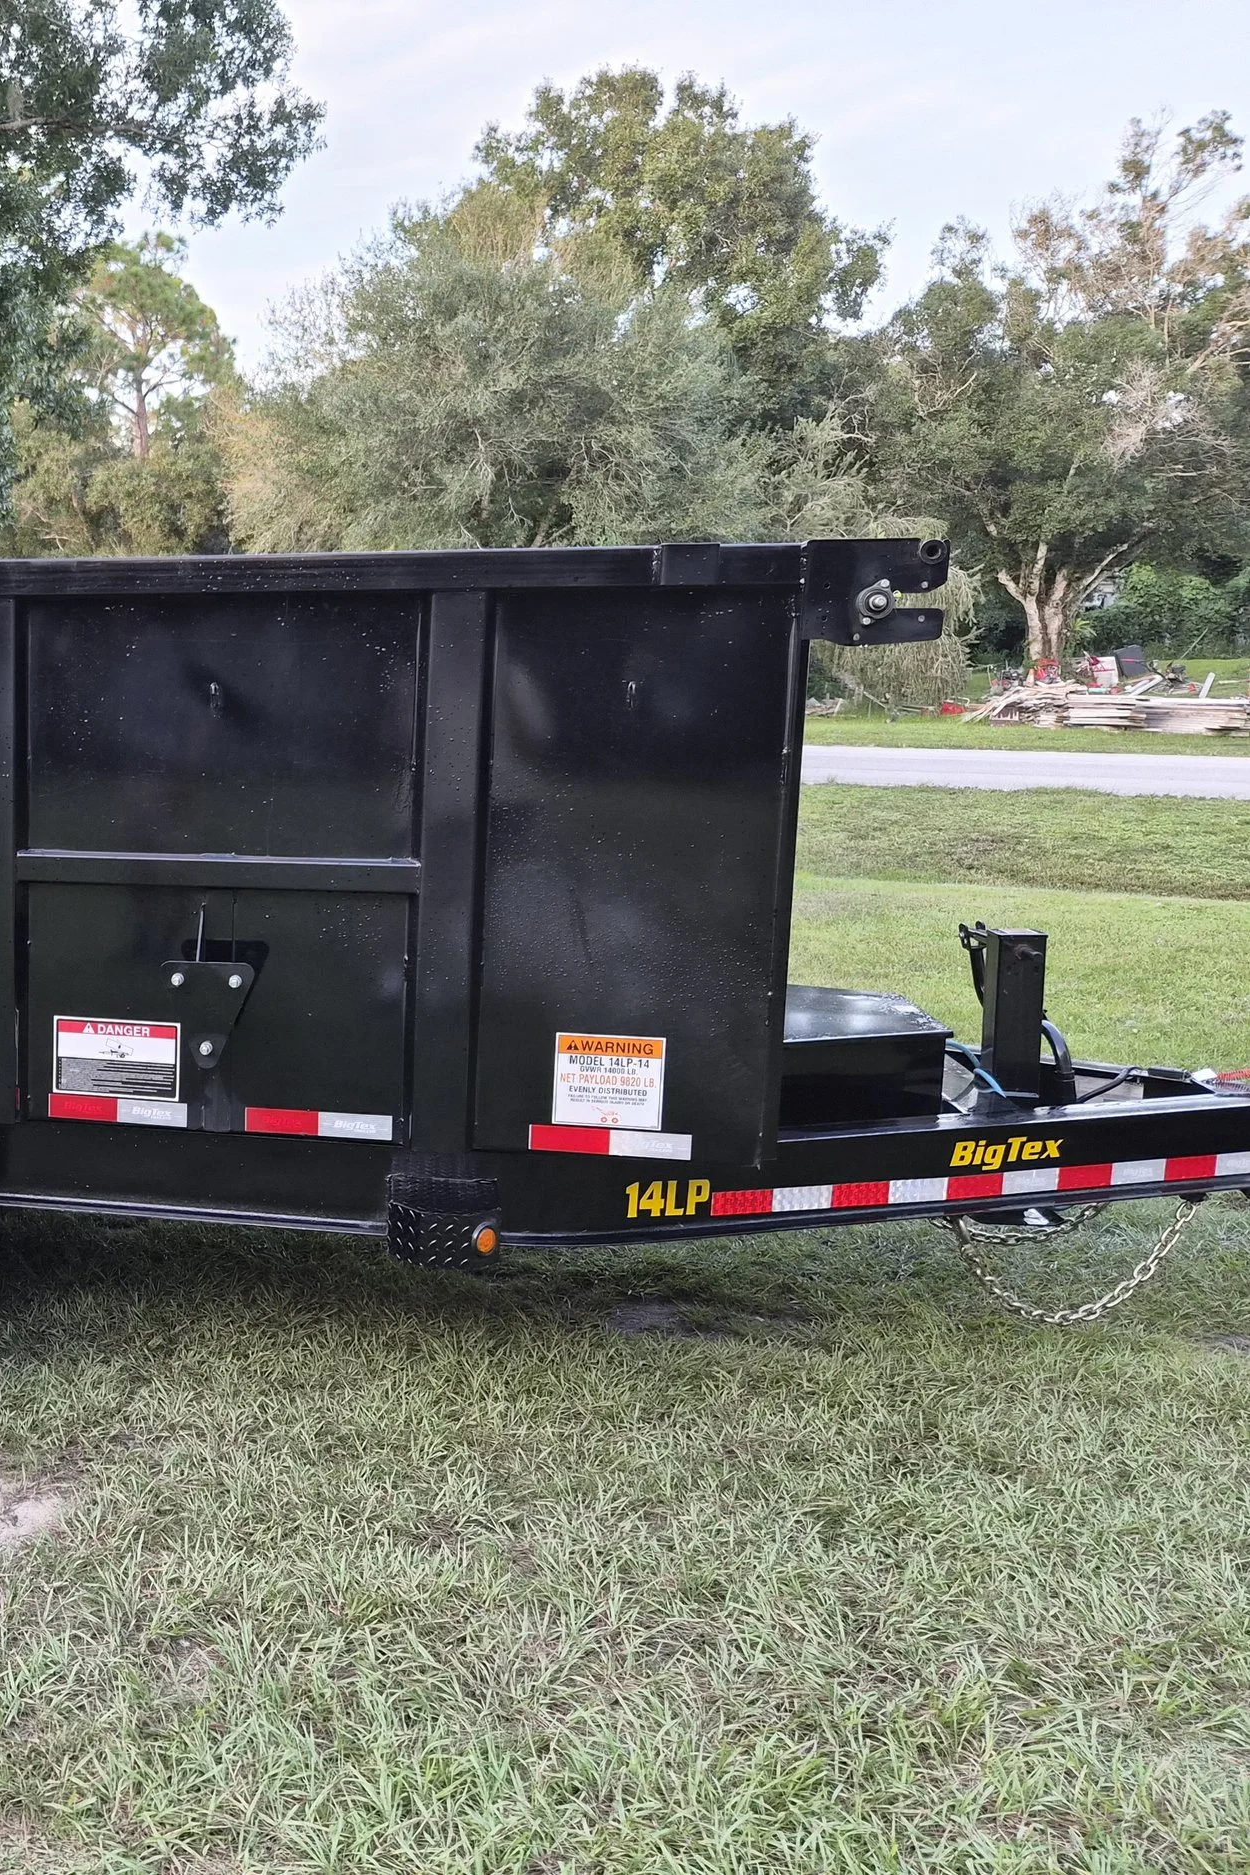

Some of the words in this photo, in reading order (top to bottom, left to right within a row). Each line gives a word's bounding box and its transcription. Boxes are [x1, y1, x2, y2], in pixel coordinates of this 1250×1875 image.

[97, 1024, 150, 1037] DANGER
[581, 1040, 654, 1055] WARNING
[569, 1055, 605, 1066] MODEL
[609, 1058, 650, 1069] 14LP-14
[604, 1067, 625, 1075] 14000
[560, 1073, 576, 1083] NET
[579, 1074, 617, 1086] PAYLOAD
[620, 1077, 641, 1088] 9820
[644, 1078, 657, 1089] LB.
[569, 1086, 596, 1094] EVENLY
[599, 1088, 648, 1097] DISTRIBUTED
[132, 1106, 172, 1118] BigTex
[333, 1120, 377, 1132] BigTex
[950, 1136, 1064, 1171] BigTex
[625, 1179, 711, 1218] 14LP
